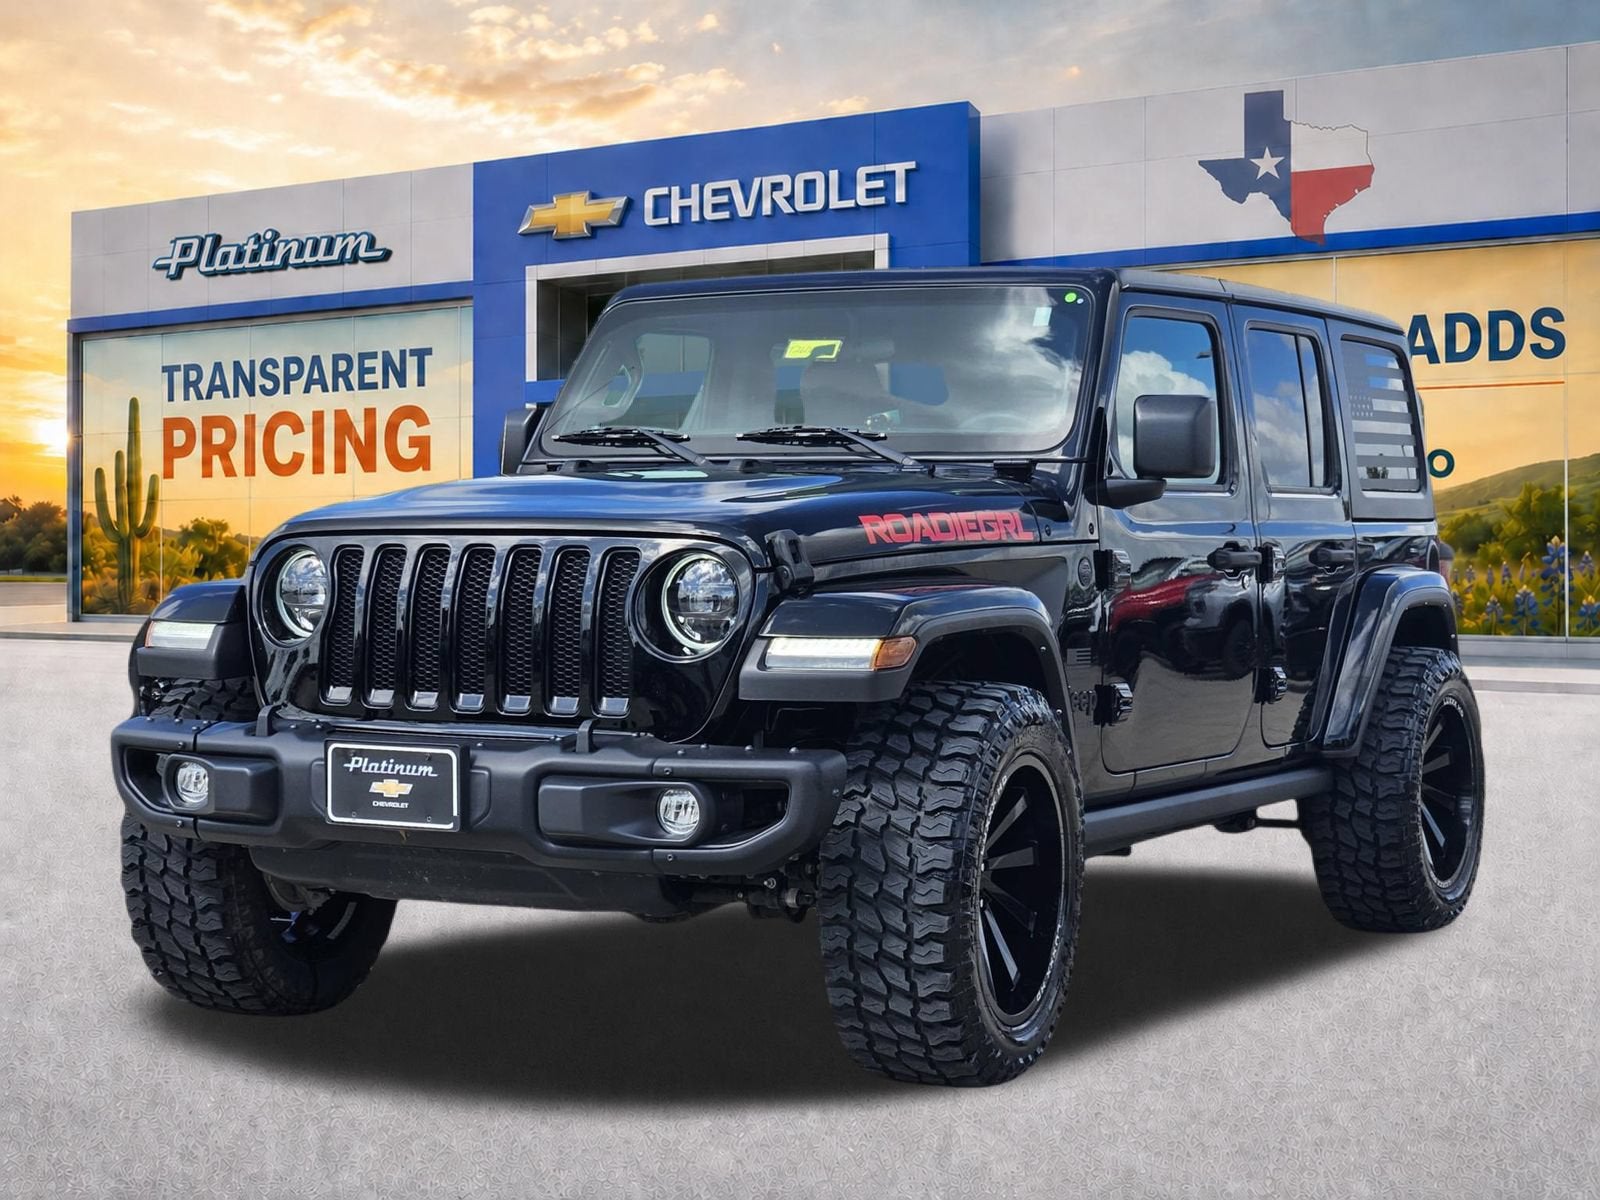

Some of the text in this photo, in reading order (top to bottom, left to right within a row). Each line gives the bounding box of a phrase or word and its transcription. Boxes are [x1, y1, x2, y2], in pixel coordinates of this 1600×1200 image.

[644, 160, 917, 227] CHEVROLET
[153, 228, 392, 280] Platinum
[161, 347, 433, 402] TRANSPARENT
[162, 404, 431, 479] PRICING
[858, 511, 1035, 545] ROADIEGRL
[343, 756, 439, 777] Platinum
[372, 800, 409, 809] CHEVROLET
